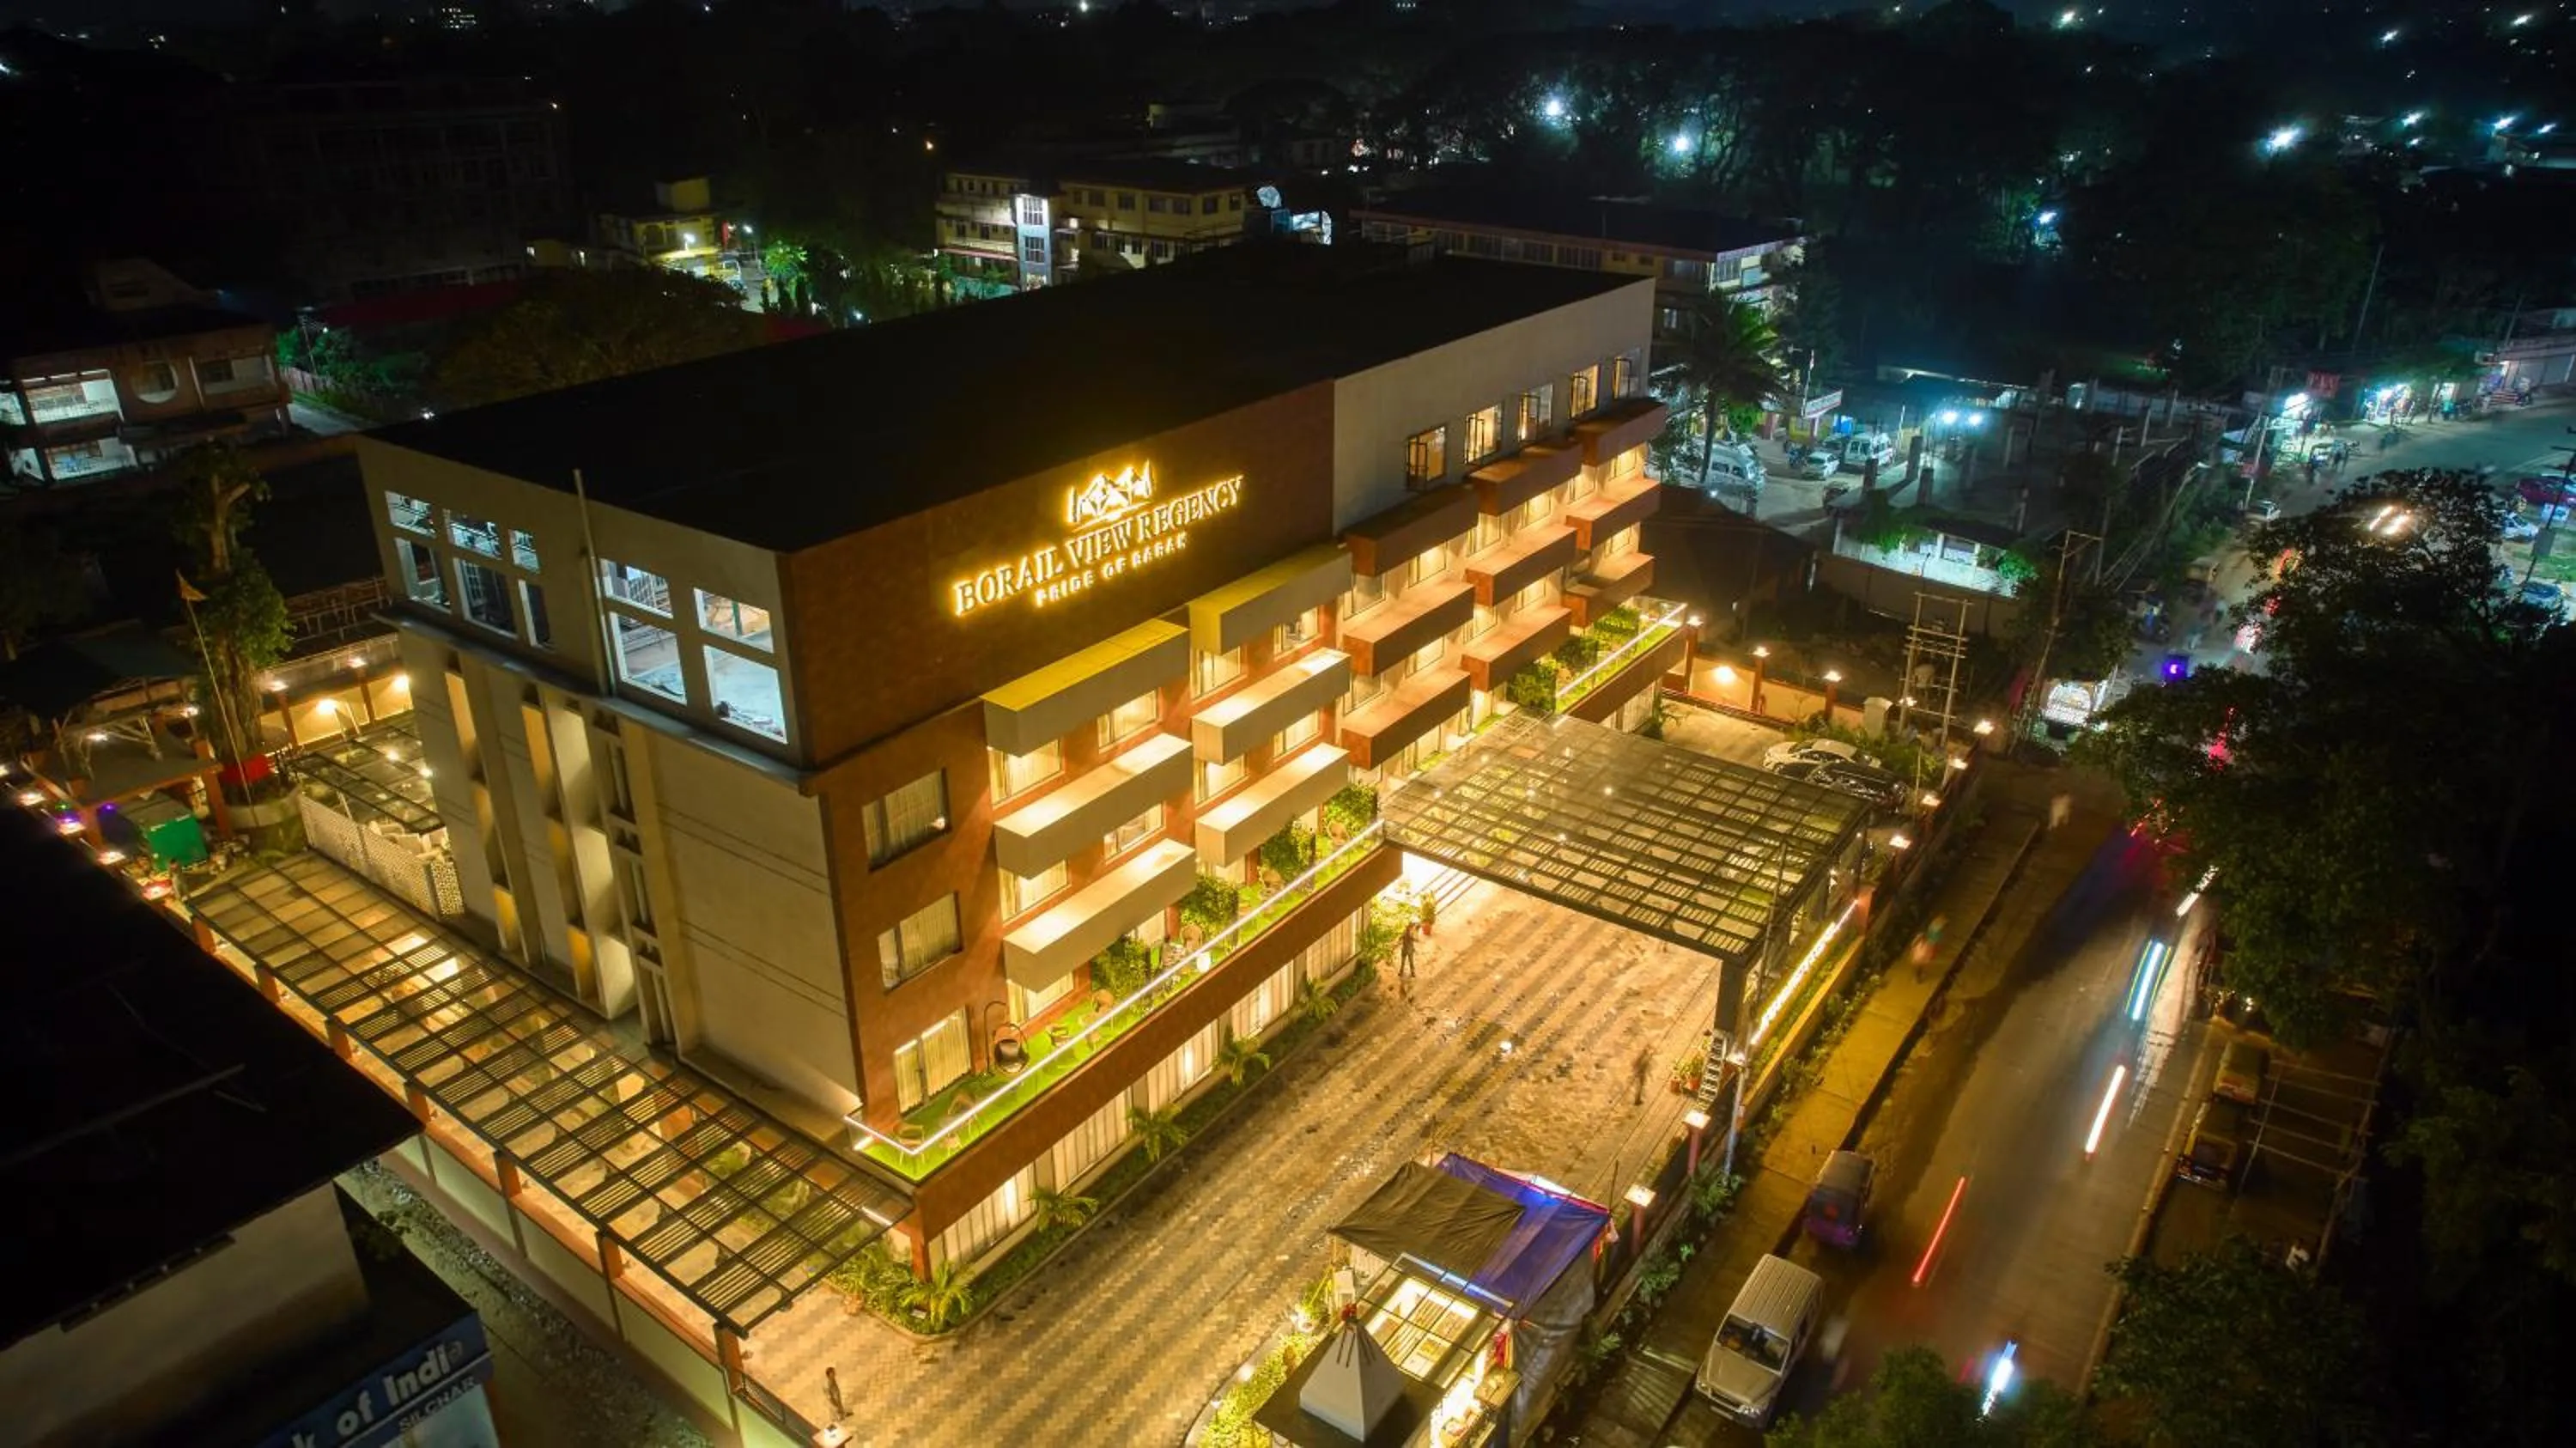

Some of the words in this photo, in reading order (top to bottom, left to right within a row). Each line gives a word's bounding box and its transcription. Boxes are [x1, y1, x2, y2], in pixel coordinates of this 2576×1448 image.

[952, 545, 1064, 617] BORAIL
[1065, 516, 1133, 569] VIEW
[1137, 474, 1244, 543] REGENCY
[1036, 570, 1095, 607] PRIDE
[1103, 557, 1127, 579] OF
[1132, 532, 1186, 568] BARAK
[337, 1390, 374, 1436] of
[382, 1340, 465, 1406] India
[398, 1376, 477, 1433] SILCHAR
